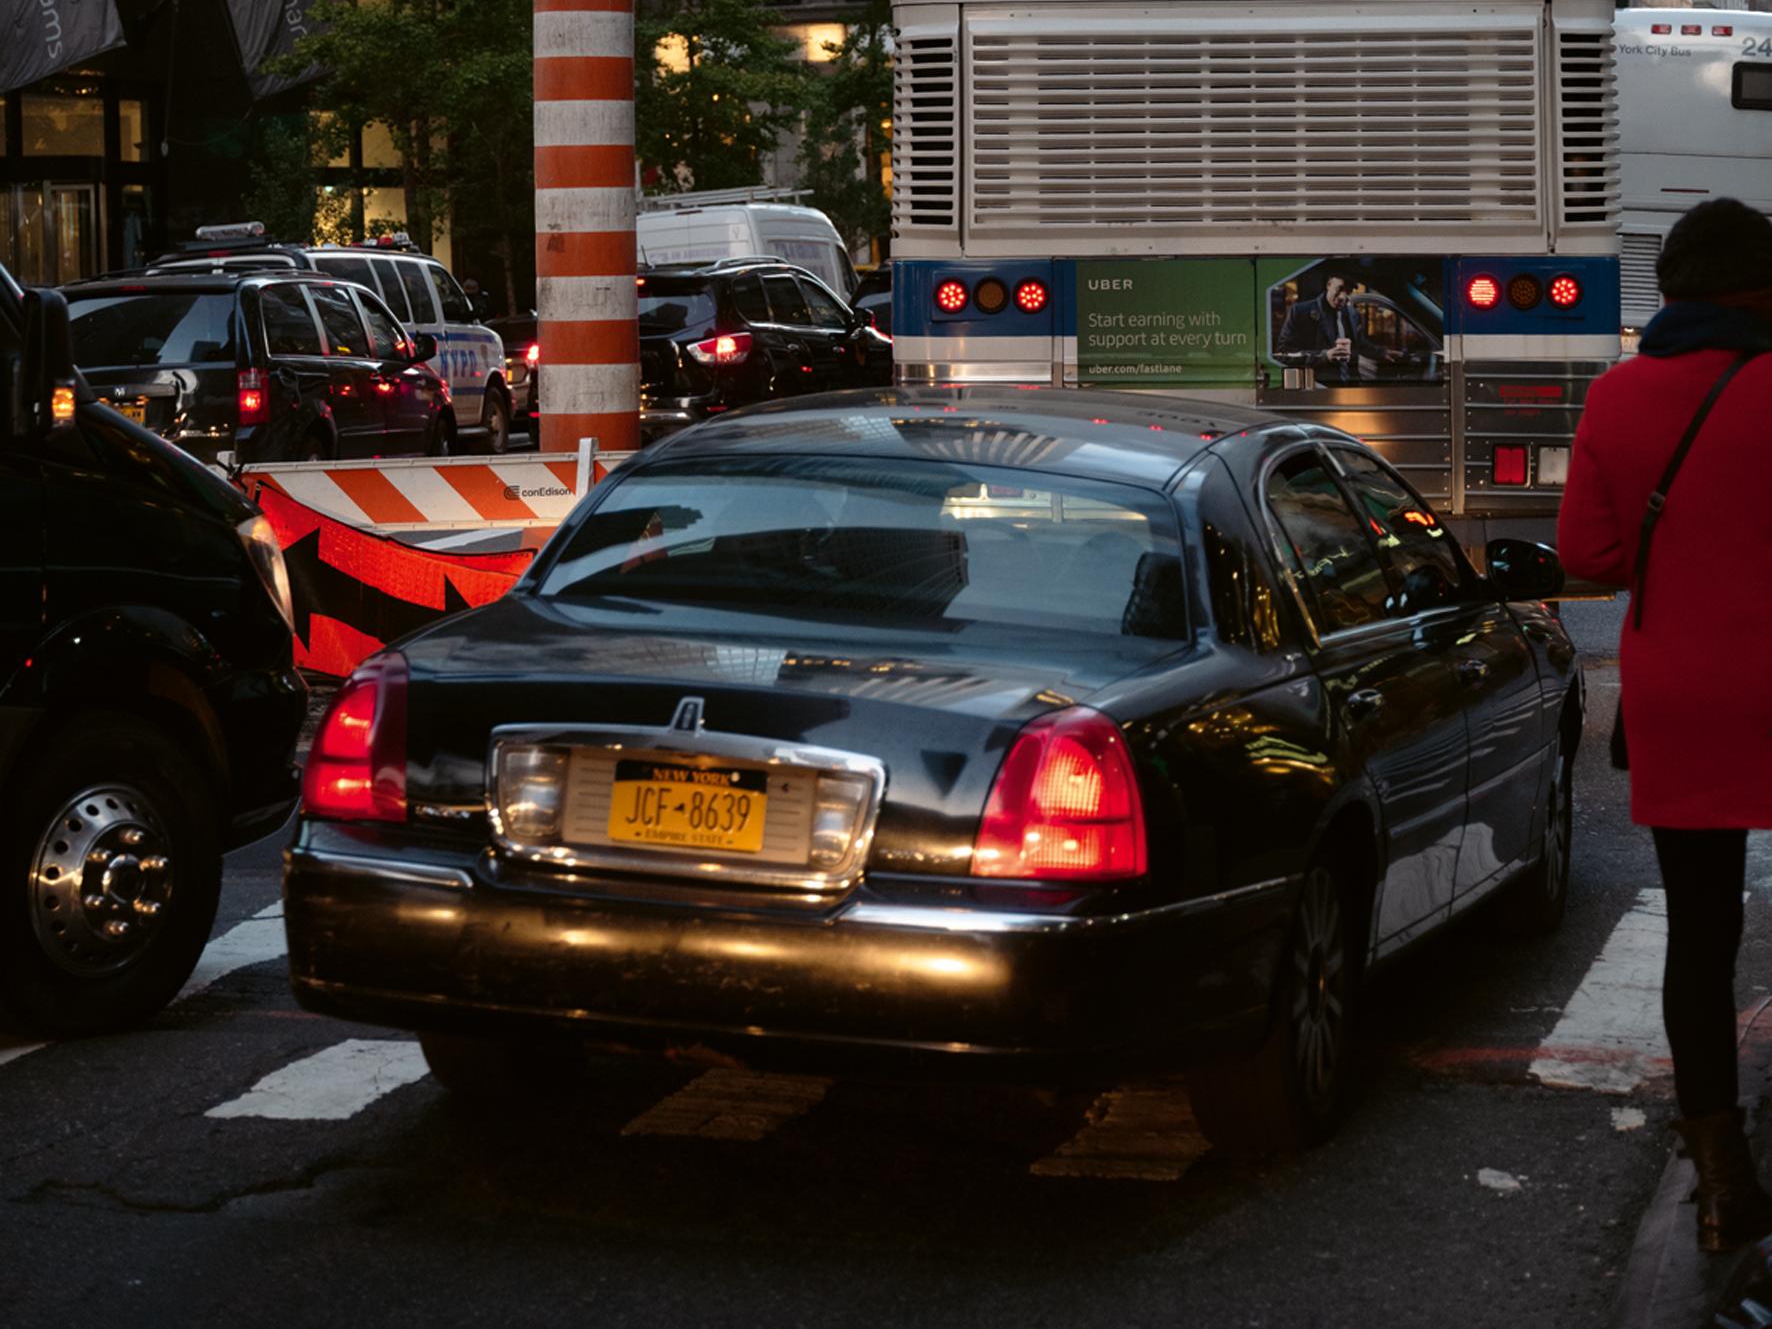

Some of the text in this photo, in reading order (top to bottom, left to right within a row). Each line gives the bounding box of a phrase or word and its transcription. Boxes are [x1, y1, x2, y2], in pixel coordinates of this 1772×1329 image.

[1618, 44, 1692, 58] York City Bus
[1088, 279, 1134, 290] UBER
[1088, 311, 1222, 330] Start earning with
[1088, 331, 1248, 349] support at every turn
[440, 349, 478, 378] NYPD
[1088, 362, 1183, 375] uber.com/fastlane
[521, 486, 572, 498] conEdison
[653, 767, 731, 787] NEW YORK
